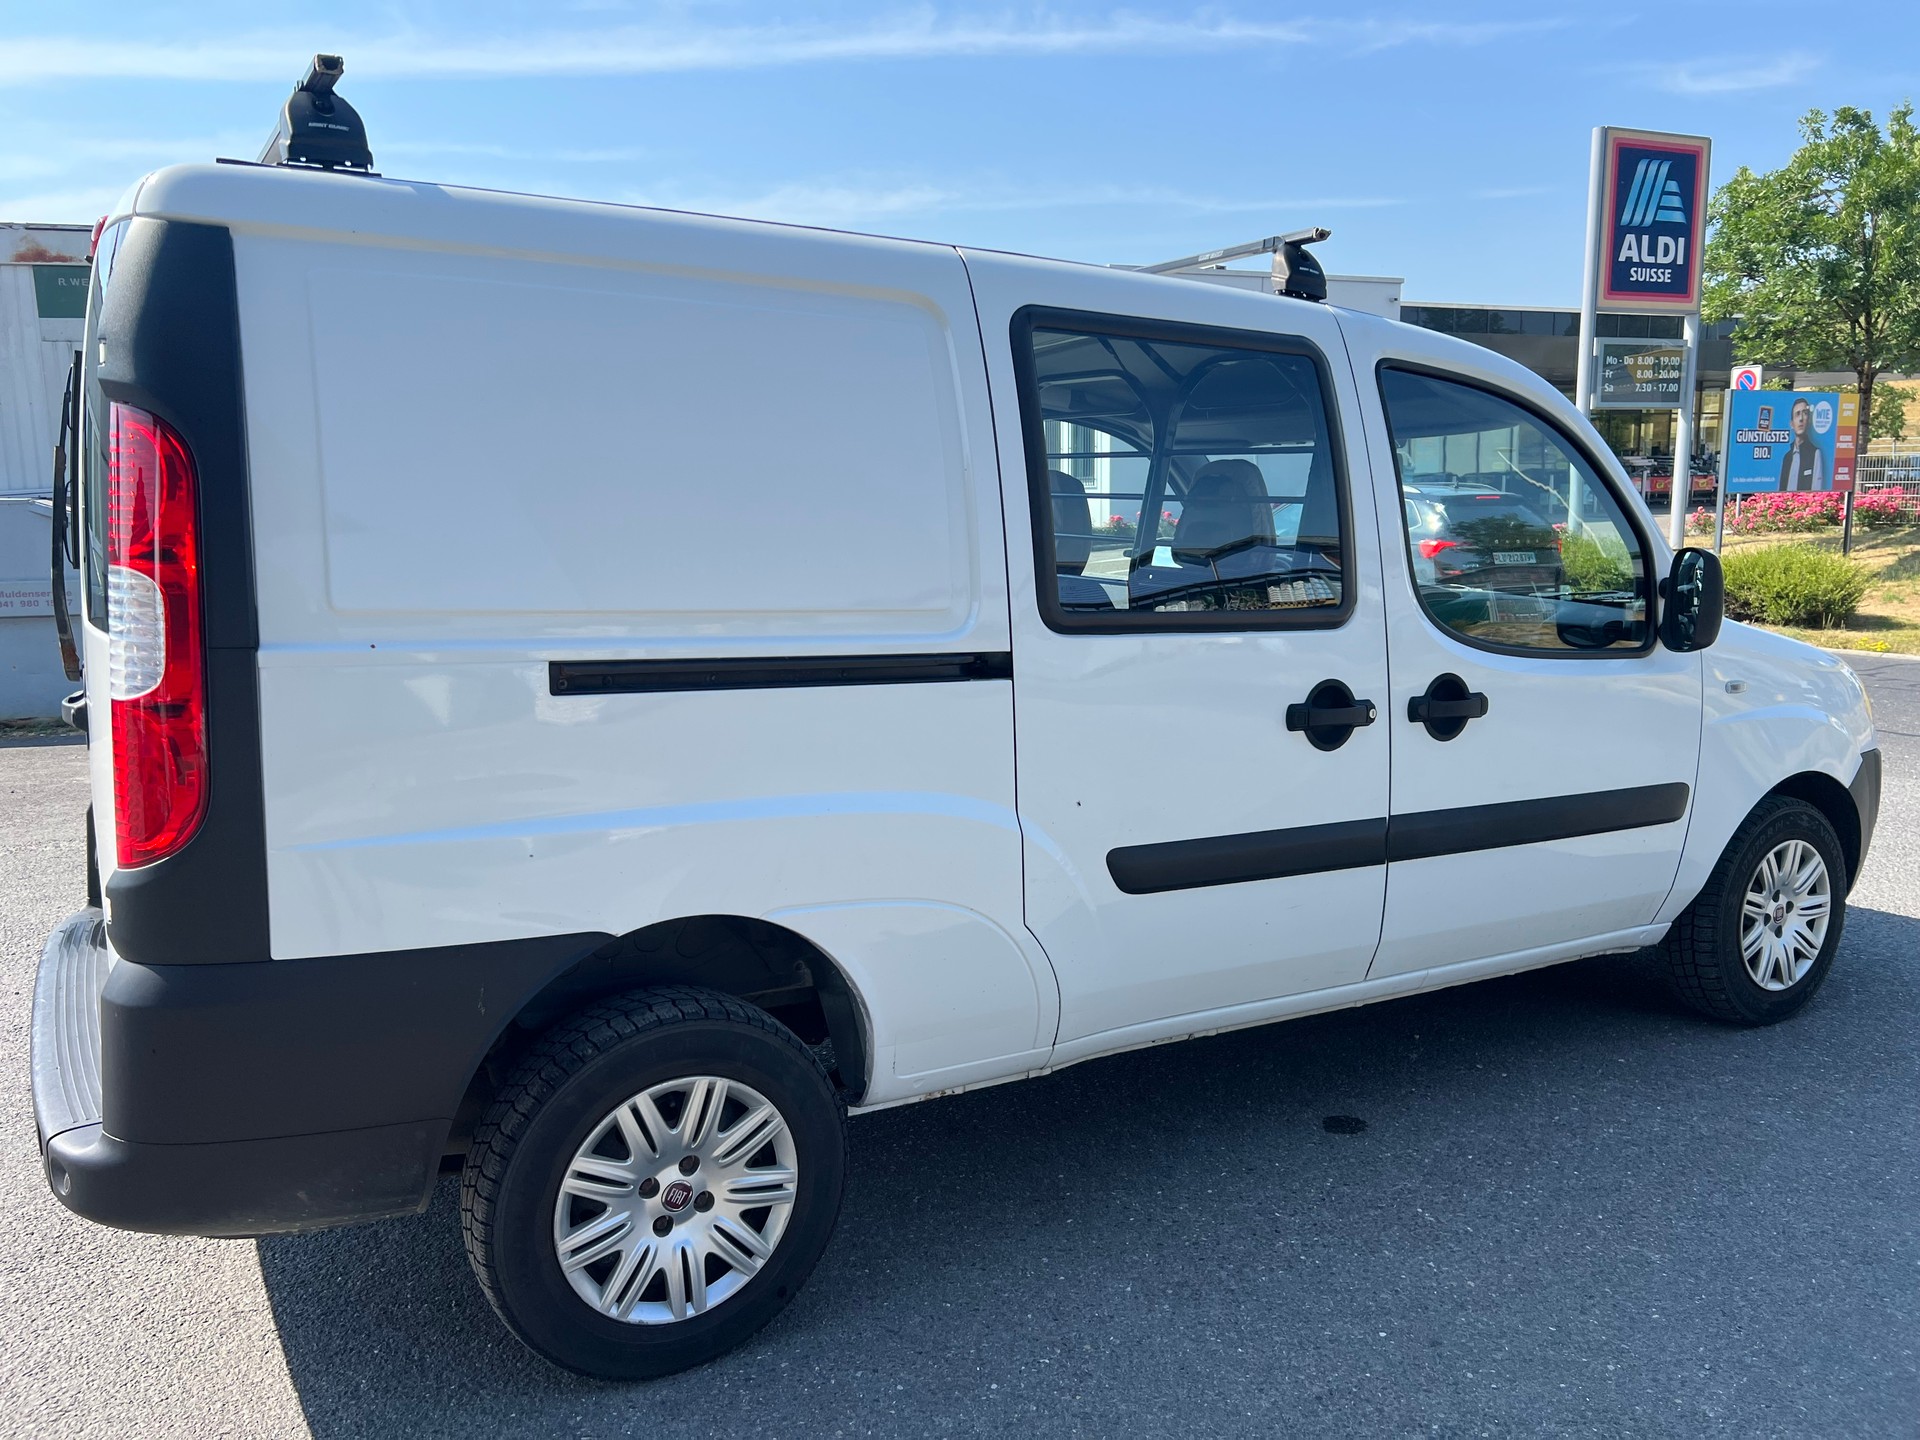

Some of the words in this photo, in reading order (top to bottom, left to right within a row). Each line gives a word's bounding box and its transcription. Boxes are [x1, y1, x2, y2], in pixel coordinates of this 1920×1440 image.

[1618, 233, 1685, 265] ALDI
[1629, 267, 1672, 282] SUISSE
[1606, 355, 1618, 365] Mo
[1623, 355, 1634, 365] Do
[1637, 356, 1654, 365] 8.00
[1660, 356, 1680, 366] 19.00
[1605, 370, 1614, 379] Fr
[1636, 370, 1653, 379] 8.00
[1659, 370, 1679, 379] 20.00
[1604, 383, 1614, 392] Sa
[1635, 384, 1652, 392] 7.30
[1658, 384, 1678, 392] 17.00
[1815, 409, 1831, 420] WIE
[1737, 429, 1789, 442] GÜNSTIGSTES
[1753, 447, 1771, 459] BIO.
[20, 600, 40, 608] 980
[667, 1187, 688, 1205] FIAT
